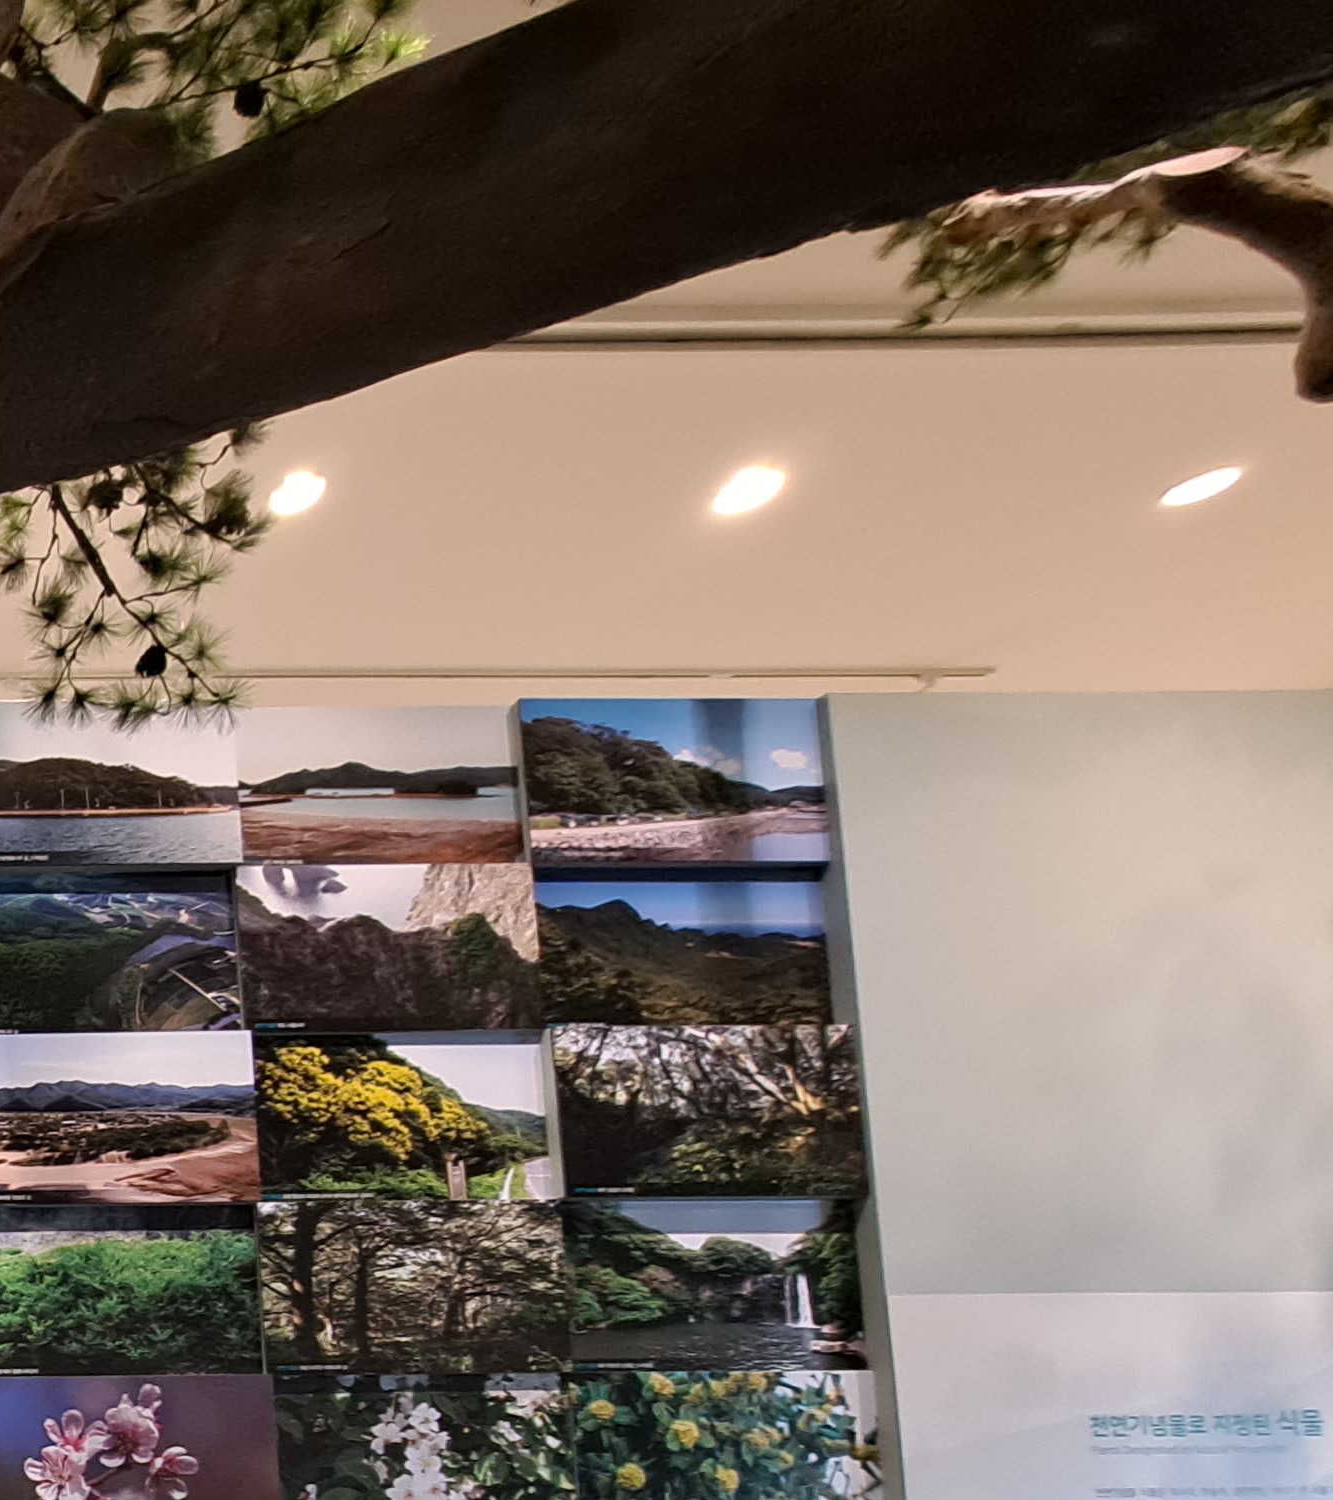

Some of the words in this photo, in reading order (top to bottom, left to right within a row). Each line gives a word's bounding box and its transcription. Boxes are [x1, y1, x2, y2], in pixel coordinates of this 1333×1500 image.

[1090, 1414, 1208, 1438] 천연기념물로
[1212, 1414, 1272, 1438] 지정된
[1276, 1408, 1325, 1438] 식물
